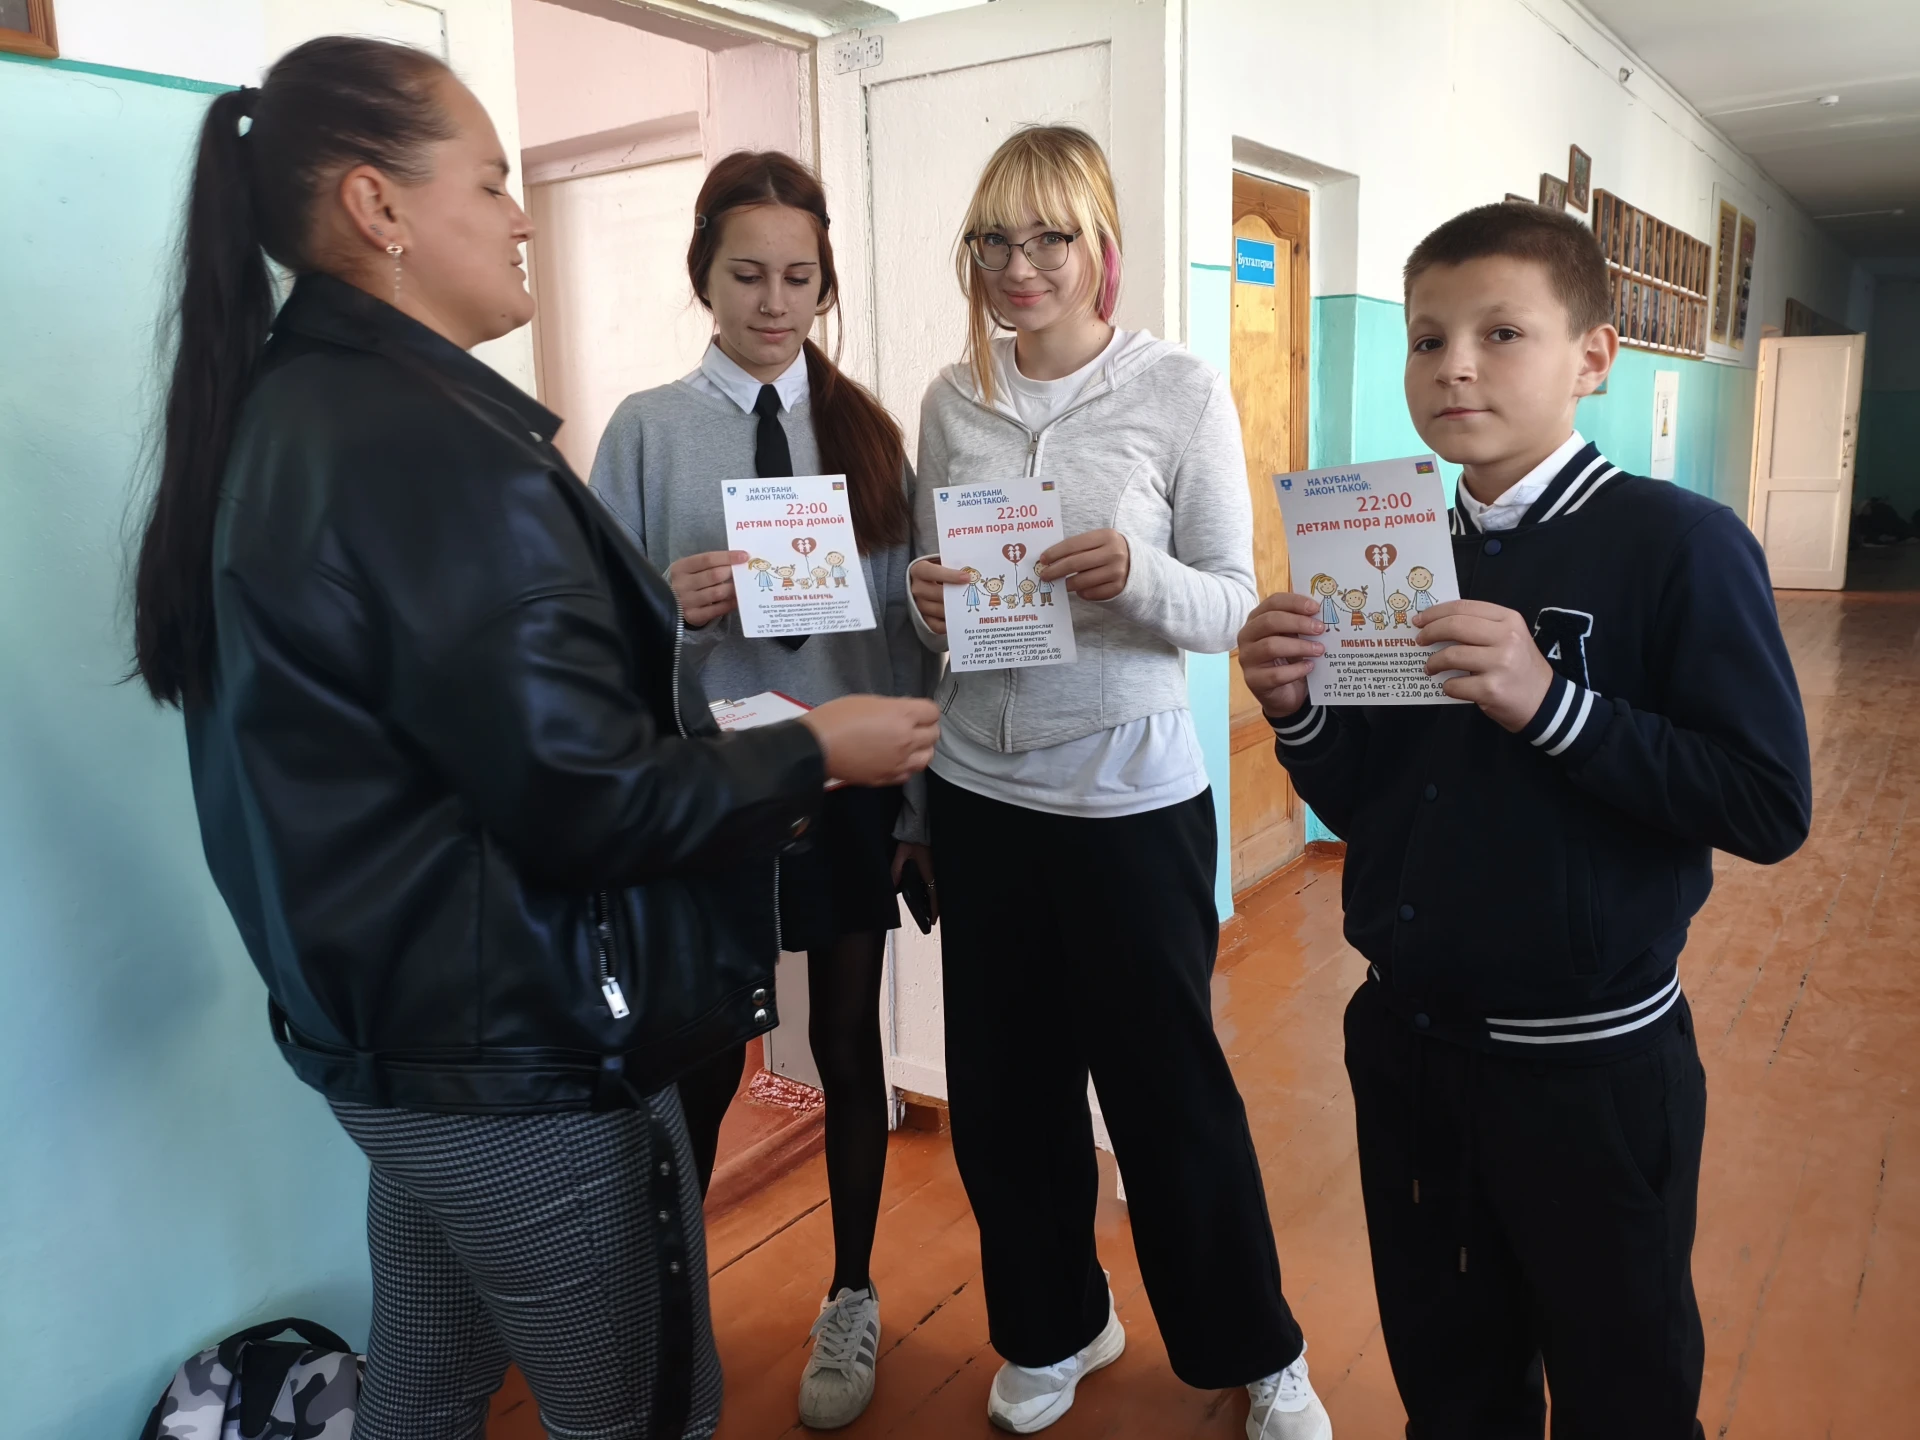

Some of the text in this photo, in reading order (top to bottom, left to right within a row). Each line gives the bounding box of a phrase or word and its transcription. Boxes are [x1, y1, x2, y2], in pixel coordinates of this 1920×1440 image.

[1238, 252, 1274, 272] Бухгалтерия
[1307, 473, 1360, 486] НА КУБАНИ
[972, 488, 1002, 498] КУБАНИ
[1304, 480, 1372, 496] ЗАКОН ТАКОЙ:
[772, 492, 799, 500] ТАКОЙ:
[957, 495, 1010, 507] ЗАКОН ТАКОЙ:
[1356, 492, 1412, 512] 22:00
[786, 502, 828, 515] 22:00
[996, 504, 1038, 520] 22:00
[736, 514, 844, 530] детям пора домой
[948, 517, 1054, 538] детям пора домой
[1296, 508, 1436, 536] детям пора домой
[979, 616, 1006, 624] ЛЮБИТЬ
[1341, 638, 1416, 648] ЛЮБИТЬ И БЕРЕЧЬ
[1338, 652, 1398, 660] сопровождения
[1400, 651, 1436, 659] взрослы
